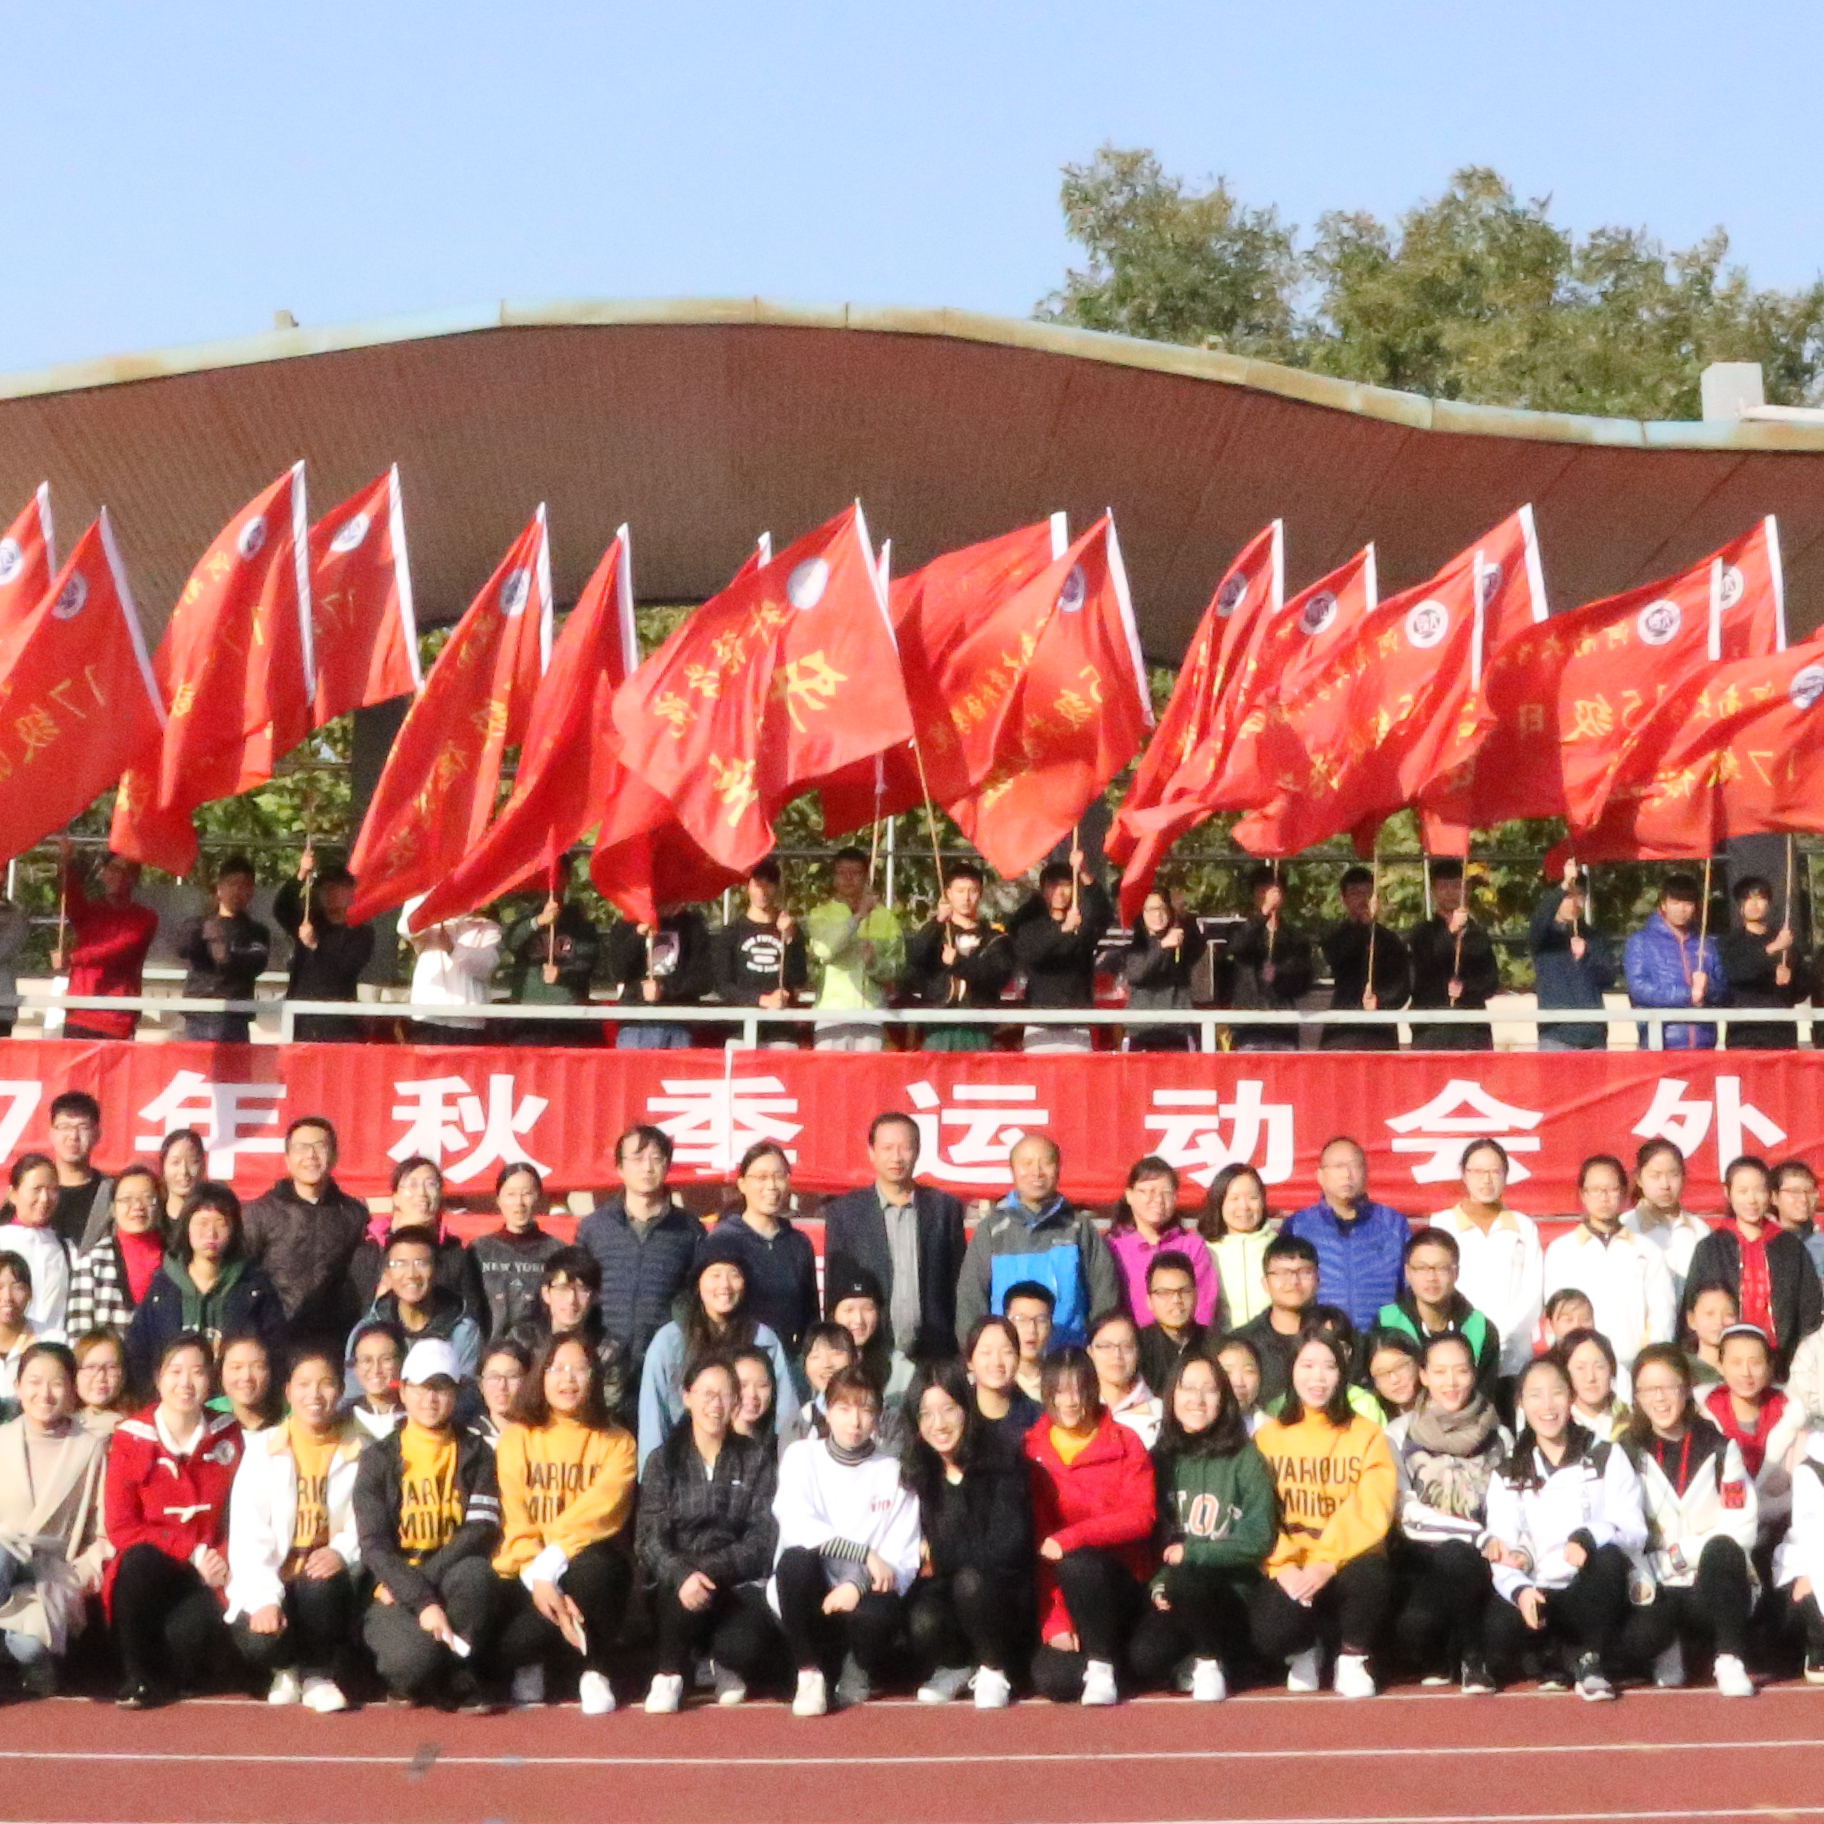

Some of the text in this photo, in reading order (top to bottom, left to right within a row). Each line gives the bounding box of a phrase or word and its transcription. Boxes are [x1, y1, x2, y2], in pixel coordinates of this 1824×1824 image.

[481, 1260, 546, 1274] NEW YOR
[1270, 1455, 1362, 1484] VARIOUS
